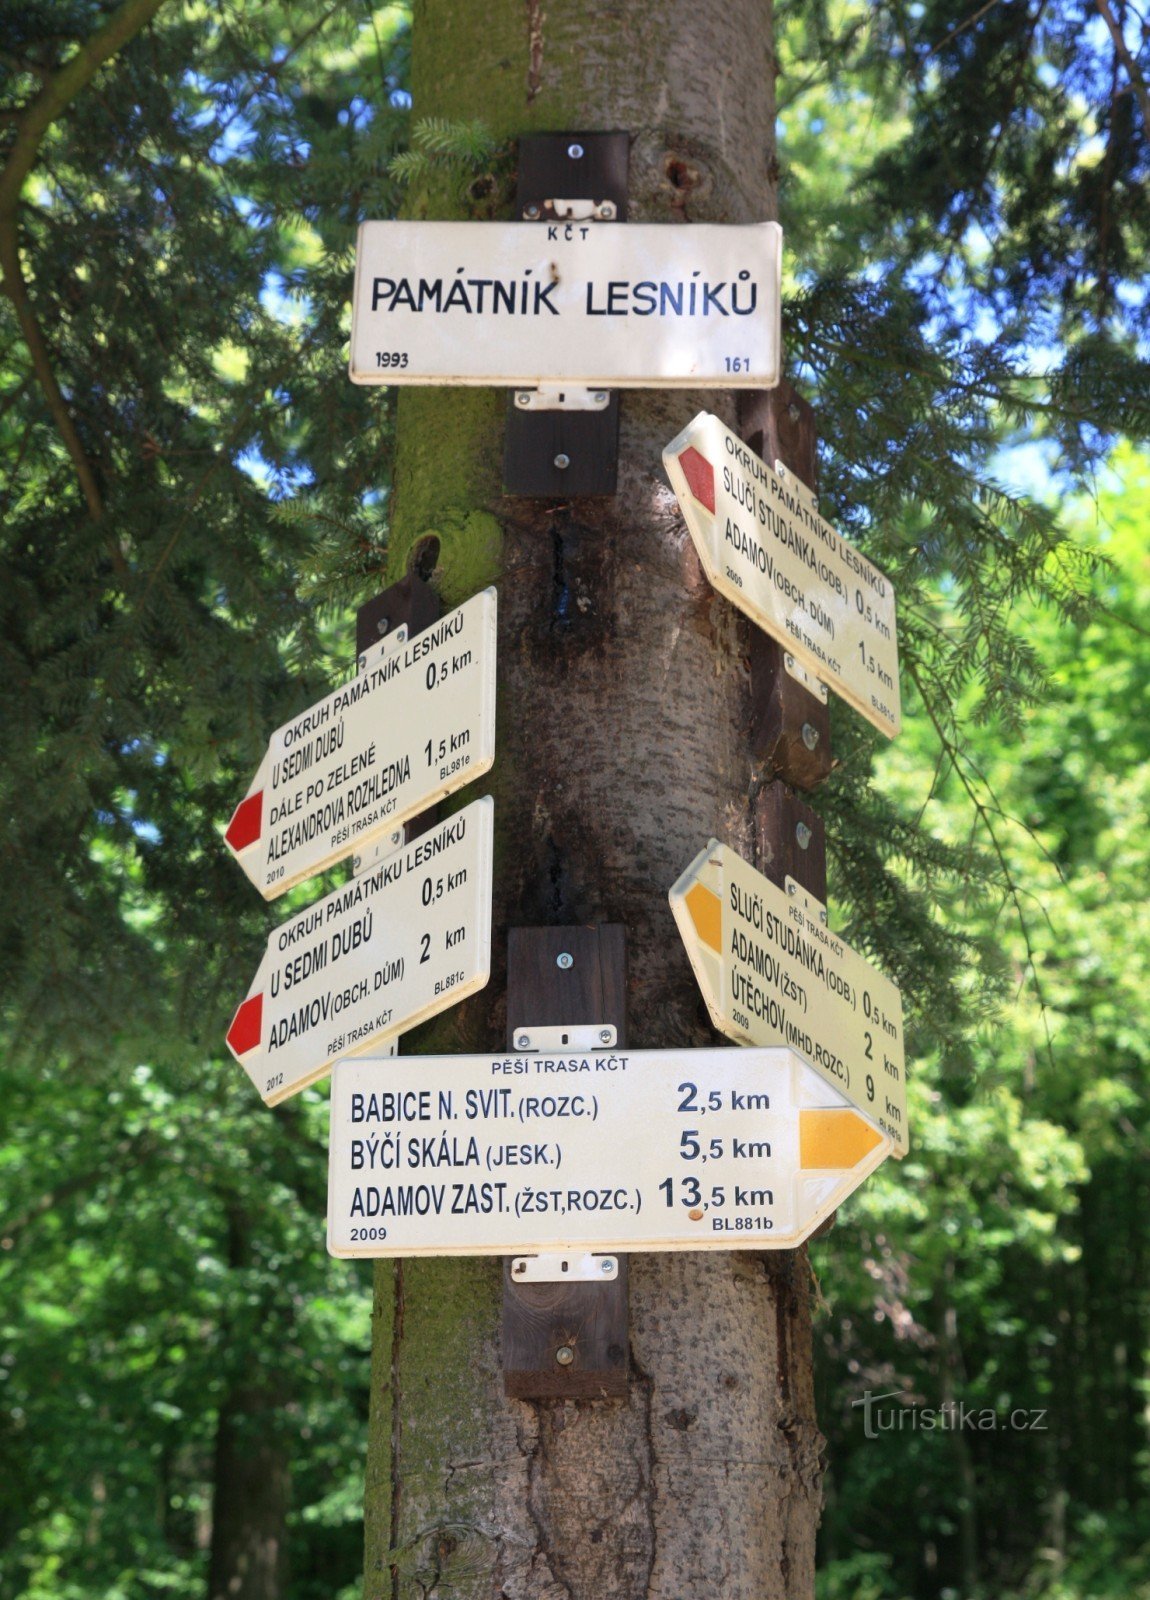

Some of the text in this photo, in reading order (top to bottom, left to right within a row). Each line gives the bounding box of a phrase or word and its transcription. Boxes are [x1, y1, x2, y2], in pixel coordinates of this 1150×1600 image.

[548, 225, 589, 241] KČT
[371, 267, 757, 316] PAMÁTNÍK LESNÍKŮ
[375, 352, 409, 369] 1993
[725, 357, 750, 373] 161
[726, 436, 885, 598] OKRUH PAMÁTNÍKU LESNÍKŮ
[723, 466, 756, 518] SLUČÍ
[856, 589, 872, 622] 0,5
[875, 613, 890, 640] km
[726, 566, 743, 587] 2009
[786, 618, 841, 674] PĚŠÍ TRASA KČT
[810, 601, 835, 640] DŮM)
[859, 640, 875, 673] 1,5
[878, 663, 893, 690] km
[284, 610, 464, 748] OKRUH PAMÁTNÍK LESNÍKŮ
[273, 650, 472, 790] U SEDMI DUBŮ 0,5 km
[270, 742, 376, 826] DÁLE PO ZELENÉ
[440, 755, 470, 780] BL981e
[267, 729, 470, 865] ALEXANDROVA ROZHLEDNA 1,5 km
[331, 797, 397, 848] PĚŠÍ TRASA KČT
[266, 866, 285, 885] 2010
[278, 816, 466, 951] OKRUH PAMÁTNÍKU LESNÍKŮ
[271, 868, 467, 999] U SEDMI DUBŮ 0,5 km
[789, 906, 844, 959] PĚŠÍ TRASA KČT
[374, 957, 405, 991] DŮM)
[420, 933, 431, 964] 2
[446, 926, 466, 950] km
[730, 882, 763, 932] SLUČÍ
[863, 991, 879, 1024] 0,5
[882, 1012, 897, 1039] km
[434, 971, 465, 995] BL881c
[327, 1009, 393, 1057] PĚŠÍ TRASA KČT
[732, 1008, 749, 1030] 2009
[491, 1056, 629, 1075] PĚŠÍ TRASA KČT
[864, 1031, 873, 1061] 2
[884, 1054, 899, 1081] km
[266, 1072, 283, 1091] 2012
[351, 1091, 431, 1123] BABICE
[438, 1090, 458, 1120] N.
[677, 1082, 723, 1115] 2,5
[731, 1090, 771, 1111] km
[866, 1074, 874, 1102] 9
[885, 1095, 901, 1122] km
[351, 1131, 401, 1170] BÝČÍ
[407, 1130, 481, 1168] SKÁLA
[679, 1129, 724, 1163] 5,5
[732, 1138, 772, 1158] km
[350, 1184, 446, 1218] ADAMOV
[658, 1176, 725, 1211] 13,5
[735, 1186, 774, 1206] km
[350, 1227, 387, 1242] 2009
[712, 1216, 773, 1231] BL881b
